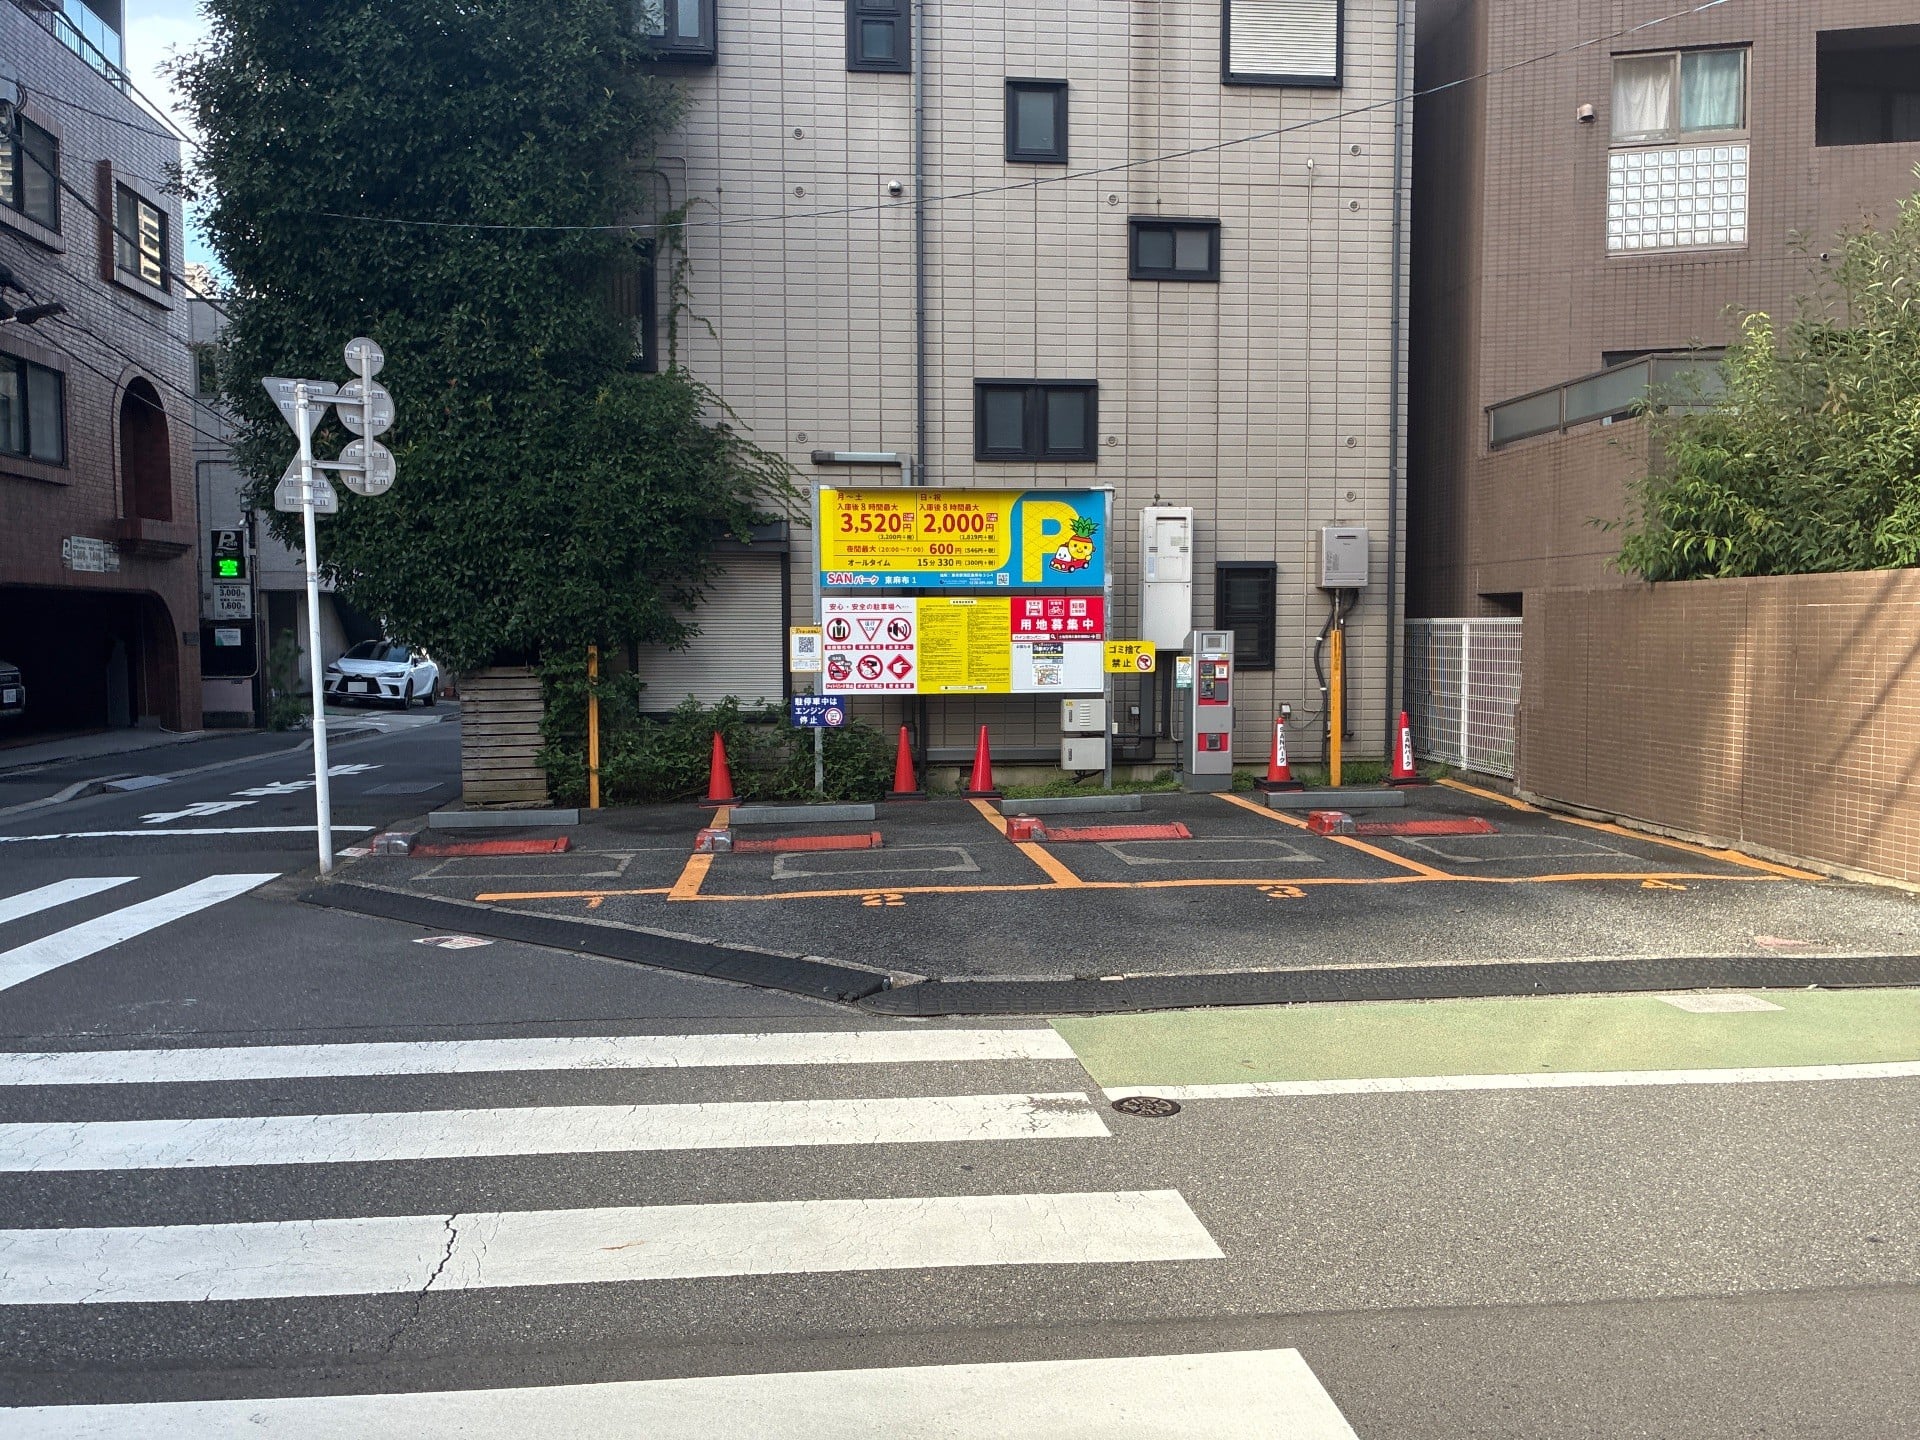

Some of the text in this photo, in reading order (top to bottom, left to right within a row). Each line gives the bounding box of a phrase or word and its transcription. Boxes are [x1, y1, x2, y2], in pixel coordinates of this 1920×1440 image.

[1022, 500, 1080, 583] P
[847, 559, 891, 567] オールタイム
[1020, 618, 1094, 631] 用地募集中
[1108, 645, 1142, 655] ゴミ捨て
[1111, 658, 1131, 668] 禁止
[794, 697, 838, 706] 駐停車中は
[794, 707, 826, 715] エンジン
[799, 716, 818, 725] 停止
